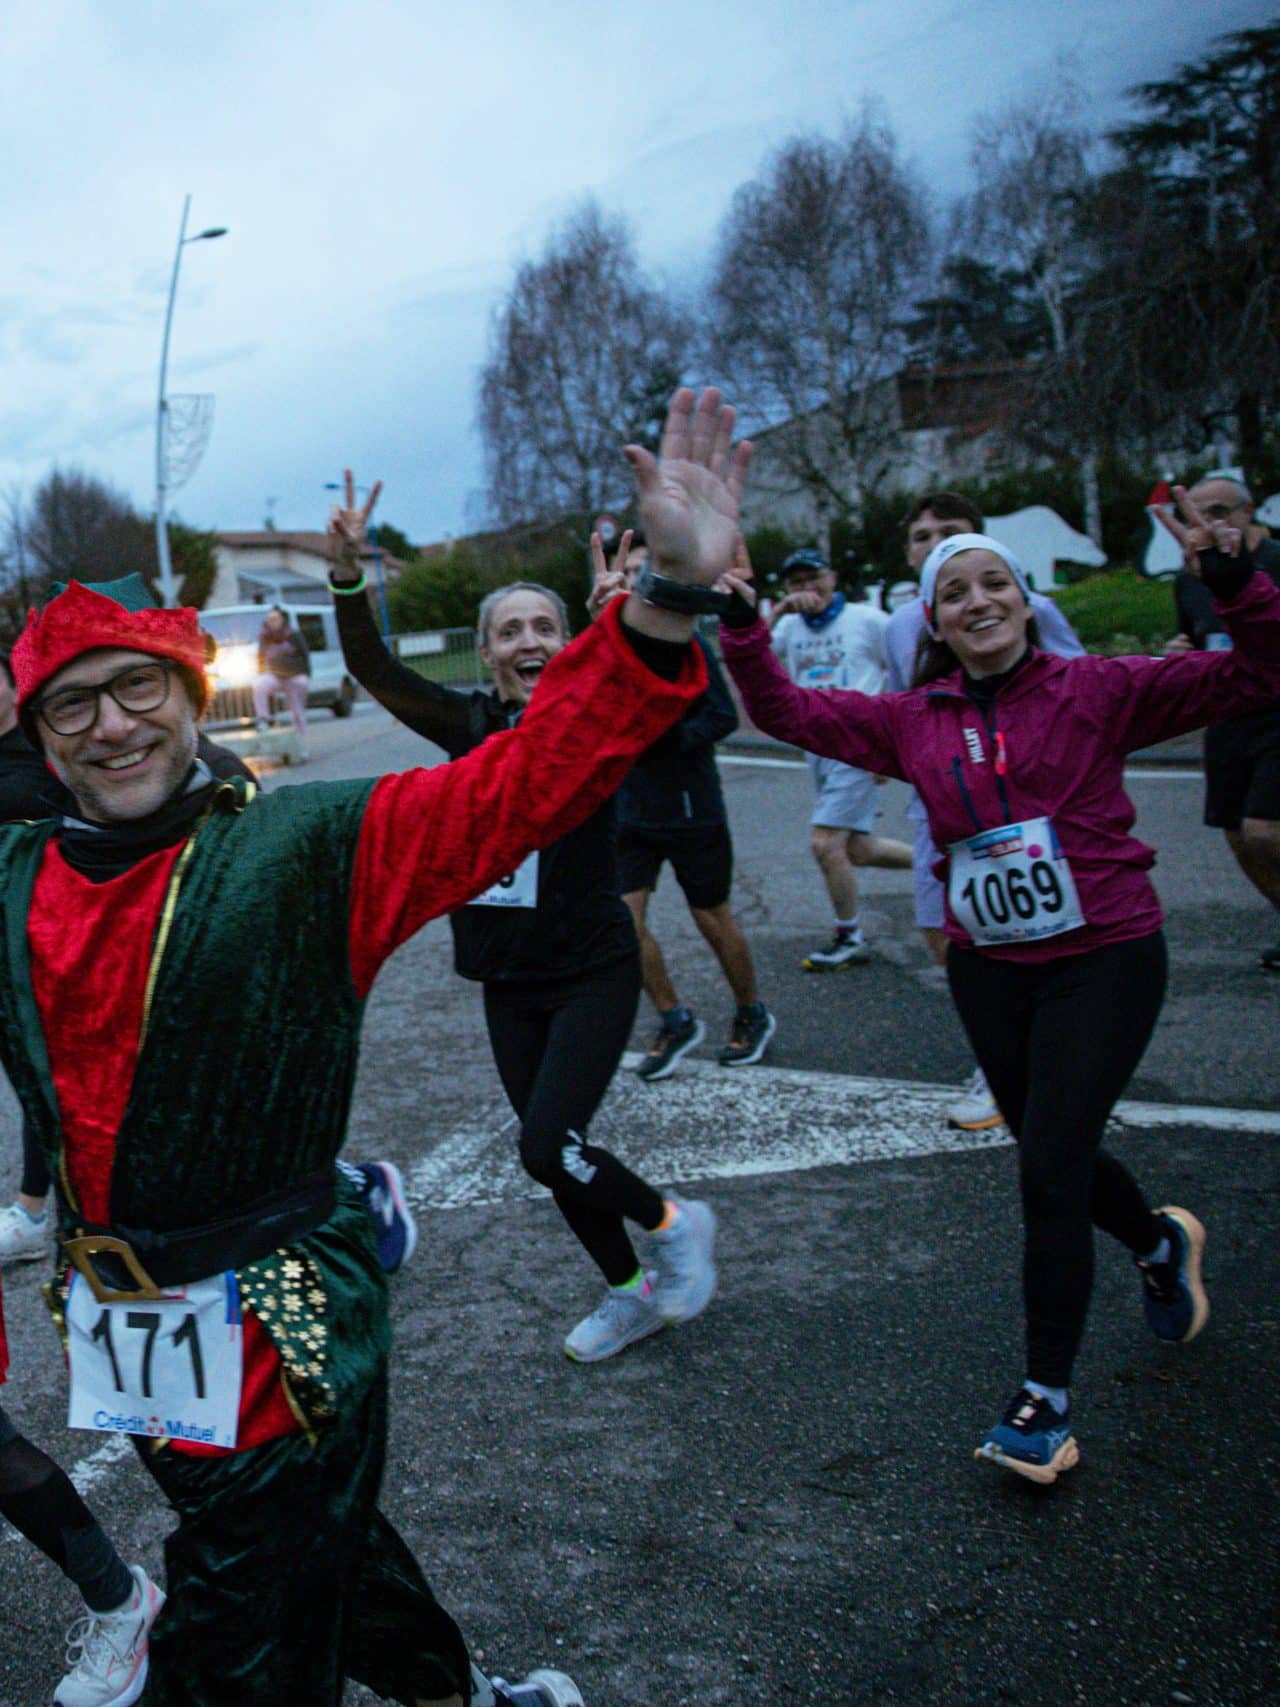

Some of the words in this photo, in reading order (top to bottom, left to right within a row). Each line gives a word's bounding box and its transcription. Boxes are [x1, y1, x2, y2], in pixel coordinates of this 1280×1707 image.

[962, 861, 1064, 927] 1069
[91, 1309, 206, 1399] 171
[165, 1419, 216, 1442] Mutuel
